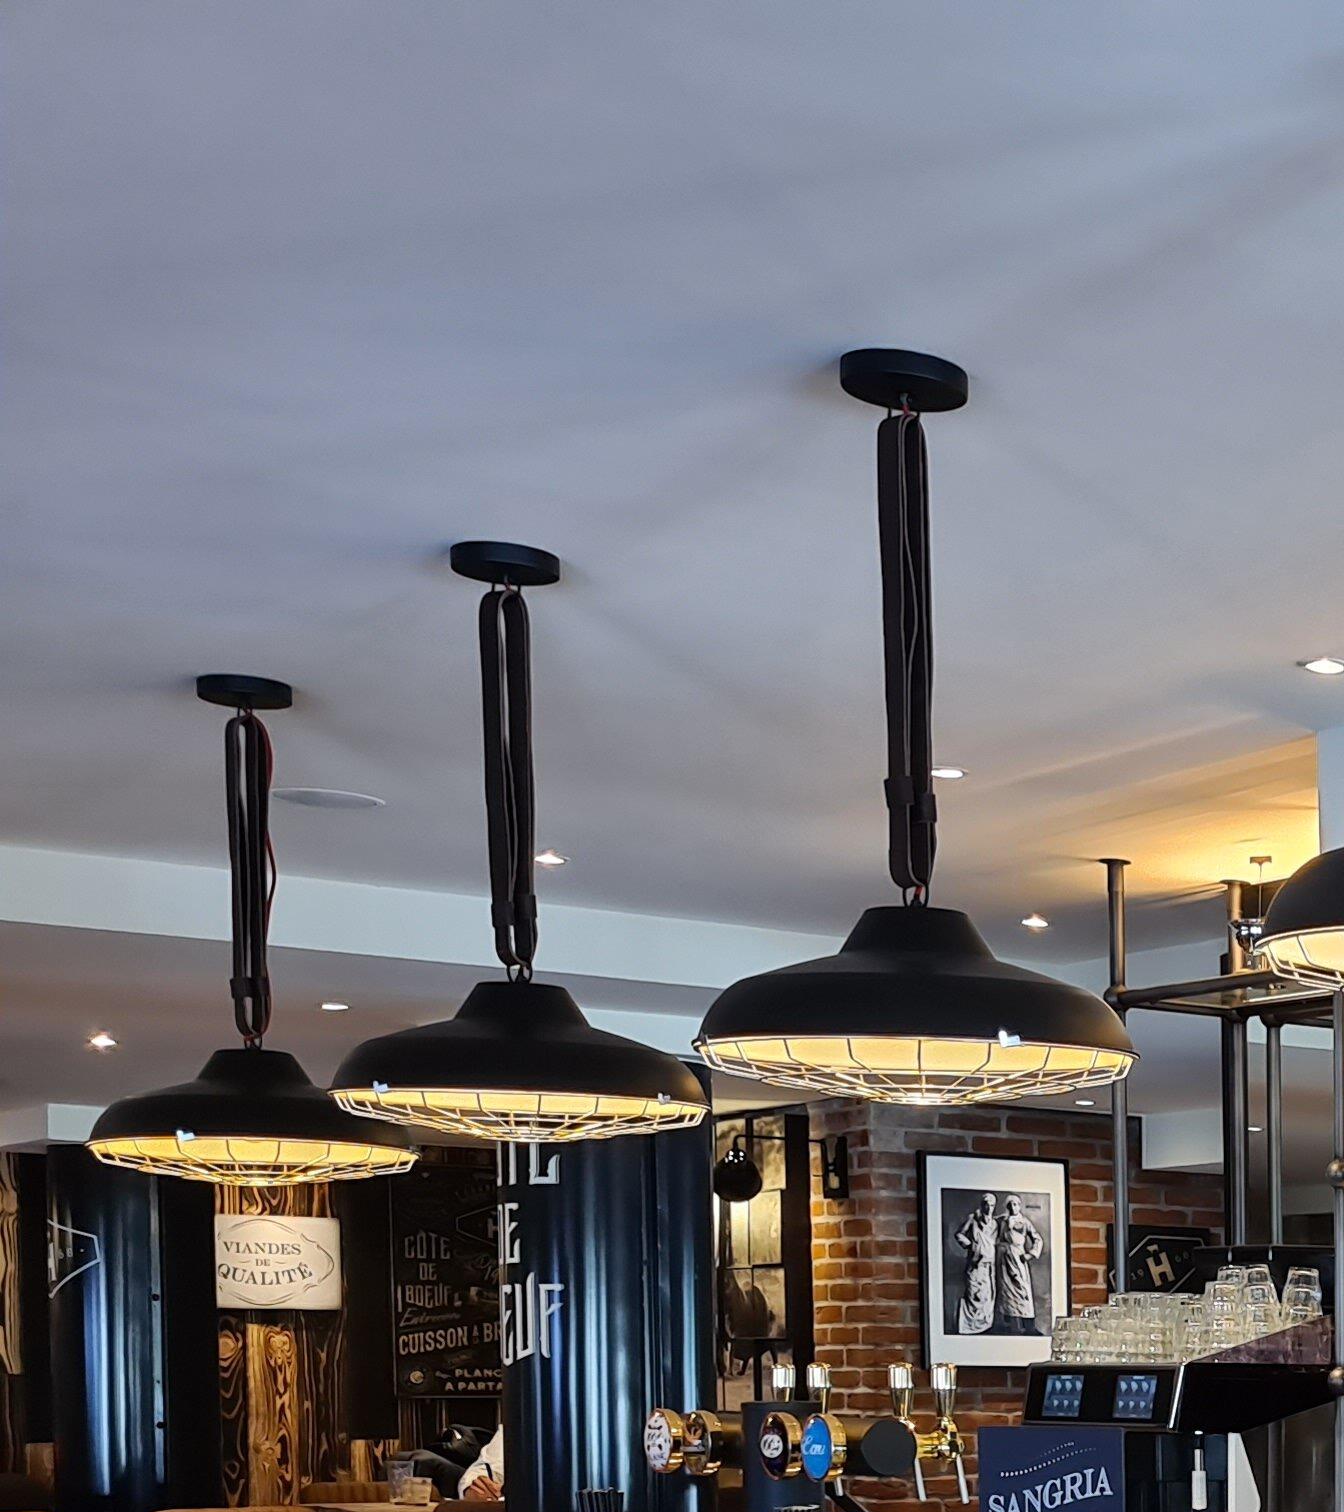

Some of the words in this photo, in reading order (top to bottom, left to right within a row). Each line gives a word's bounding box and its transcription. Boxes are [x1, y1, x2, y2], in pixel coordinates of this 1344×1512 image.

[223, 1241, 302, 1255] VIANDES
[255, 1258, 271, 1267] DE
[217, 1262, 313, 1286] QUALITÉ
[399, 1325, 469, 1356] CUISSON
